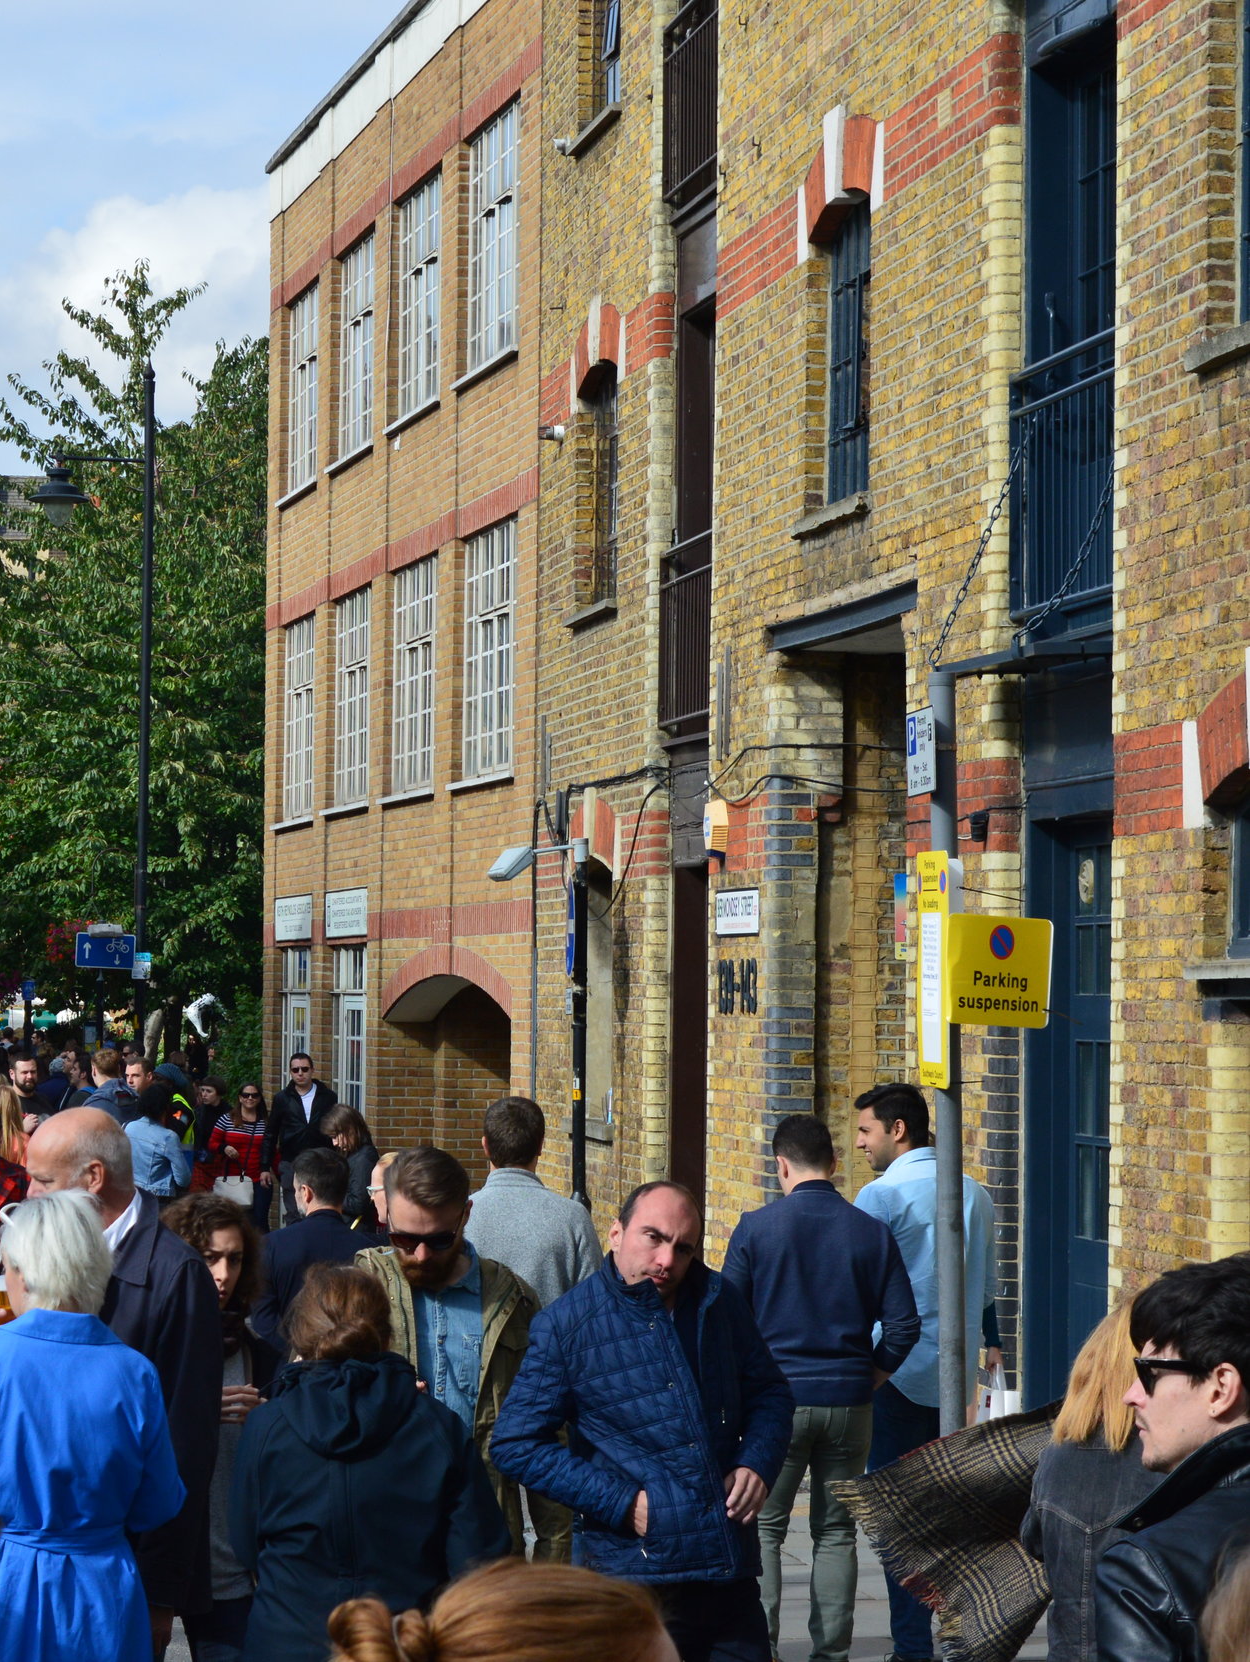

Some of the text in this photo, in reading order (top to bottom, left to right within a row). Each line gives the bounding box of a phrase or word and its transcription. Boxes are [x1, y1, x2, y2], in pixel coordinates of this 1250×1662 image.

[909, 721, 915, 754] P
[924, 860, 936, 871] Parking
[922, 875, 939, 885] suspension
[717, 897, 741, 918] BERMONDSEY
[741, 896, 754, 916] STREET
[974, 970, 1028, 993] Parking
[958, 996, 1038, 1013] suspension
